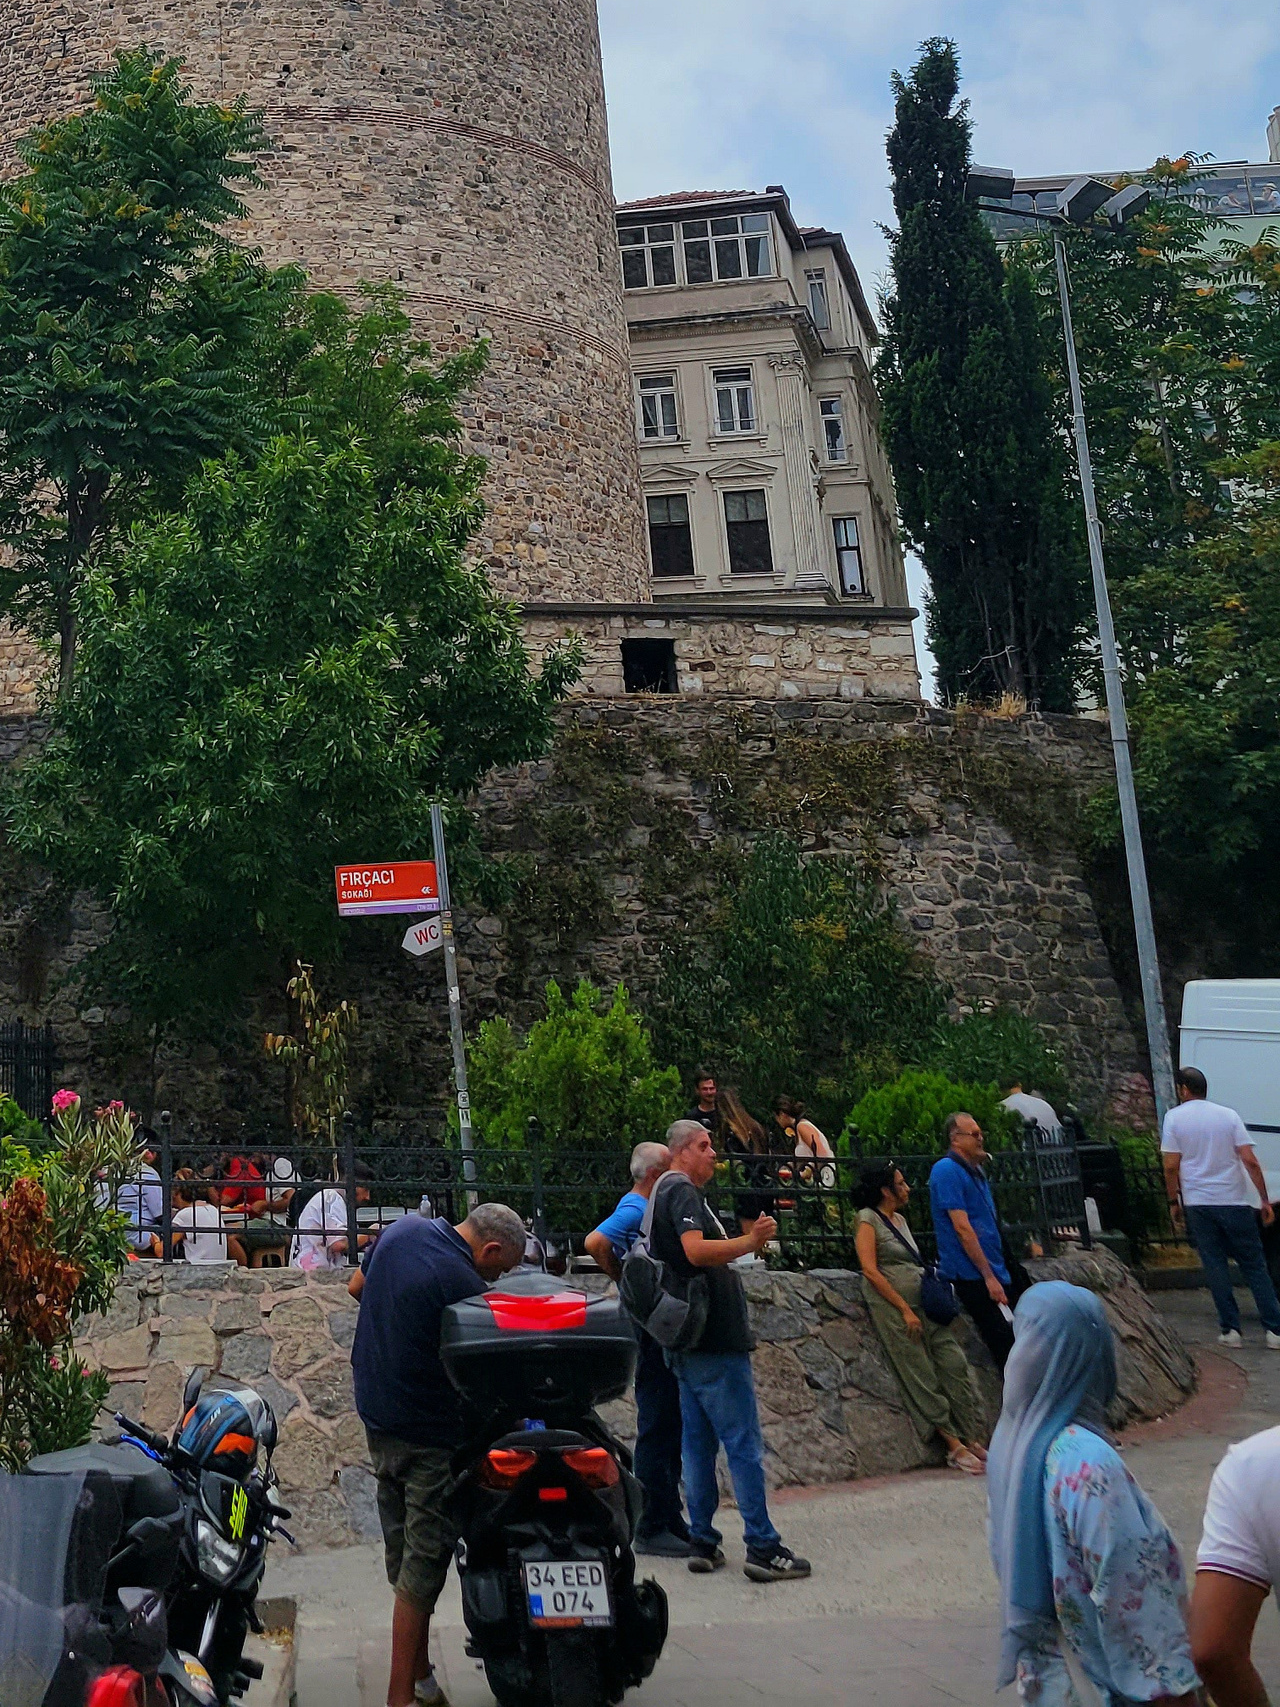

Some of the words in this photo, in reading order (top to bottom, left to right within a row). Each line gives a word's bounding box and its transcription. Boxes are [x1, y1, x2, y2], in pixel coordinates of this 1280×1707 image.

[340, 870, 395, 887] FIRÇACI
[341, 889, 372, 899] SOKAĞI
[414, 924, 439, 946] WC
[529, 1565, 555, 1588] 34
[562, 1565, 602, 1587] EED
[553, 1590, 594, 1612] 074
